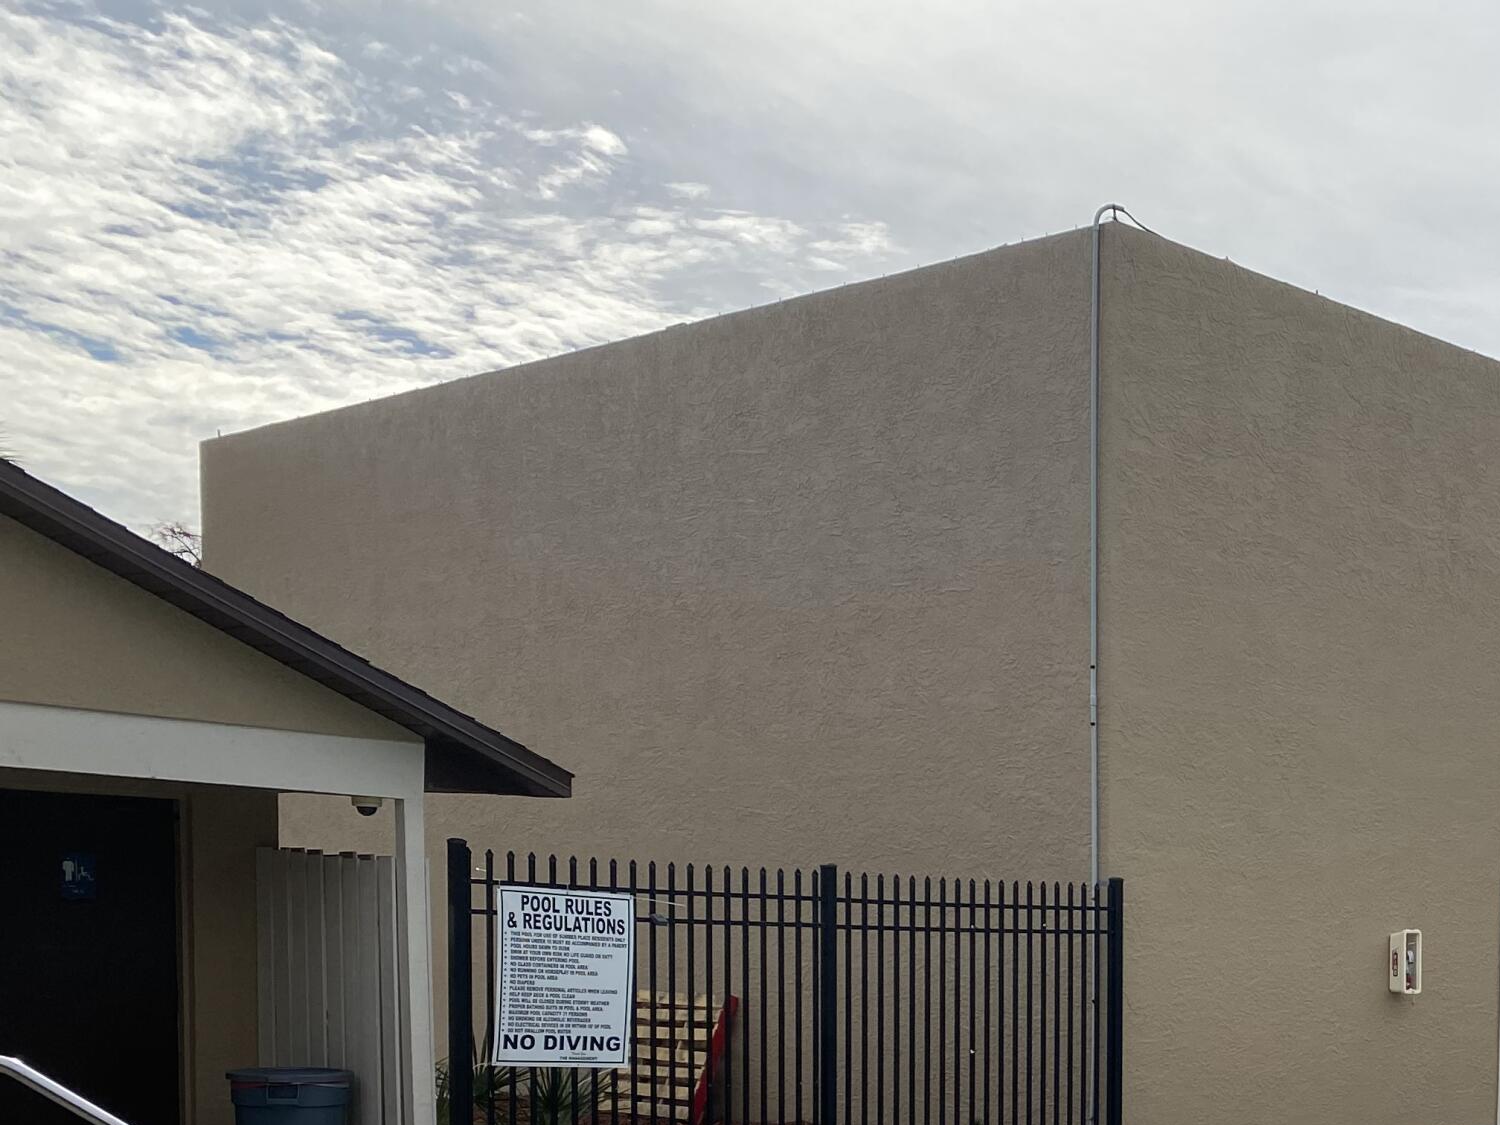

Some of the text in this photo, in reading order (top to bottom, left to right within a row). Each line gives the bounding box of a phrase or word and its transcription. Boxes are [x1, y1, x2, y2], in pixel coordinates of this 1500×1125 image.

[521, 895, 612, 917] POOL RULES
[507, 912, 625, 935] & REGULATIONS
[503, 1034, 620, 1051] NO DIVING
